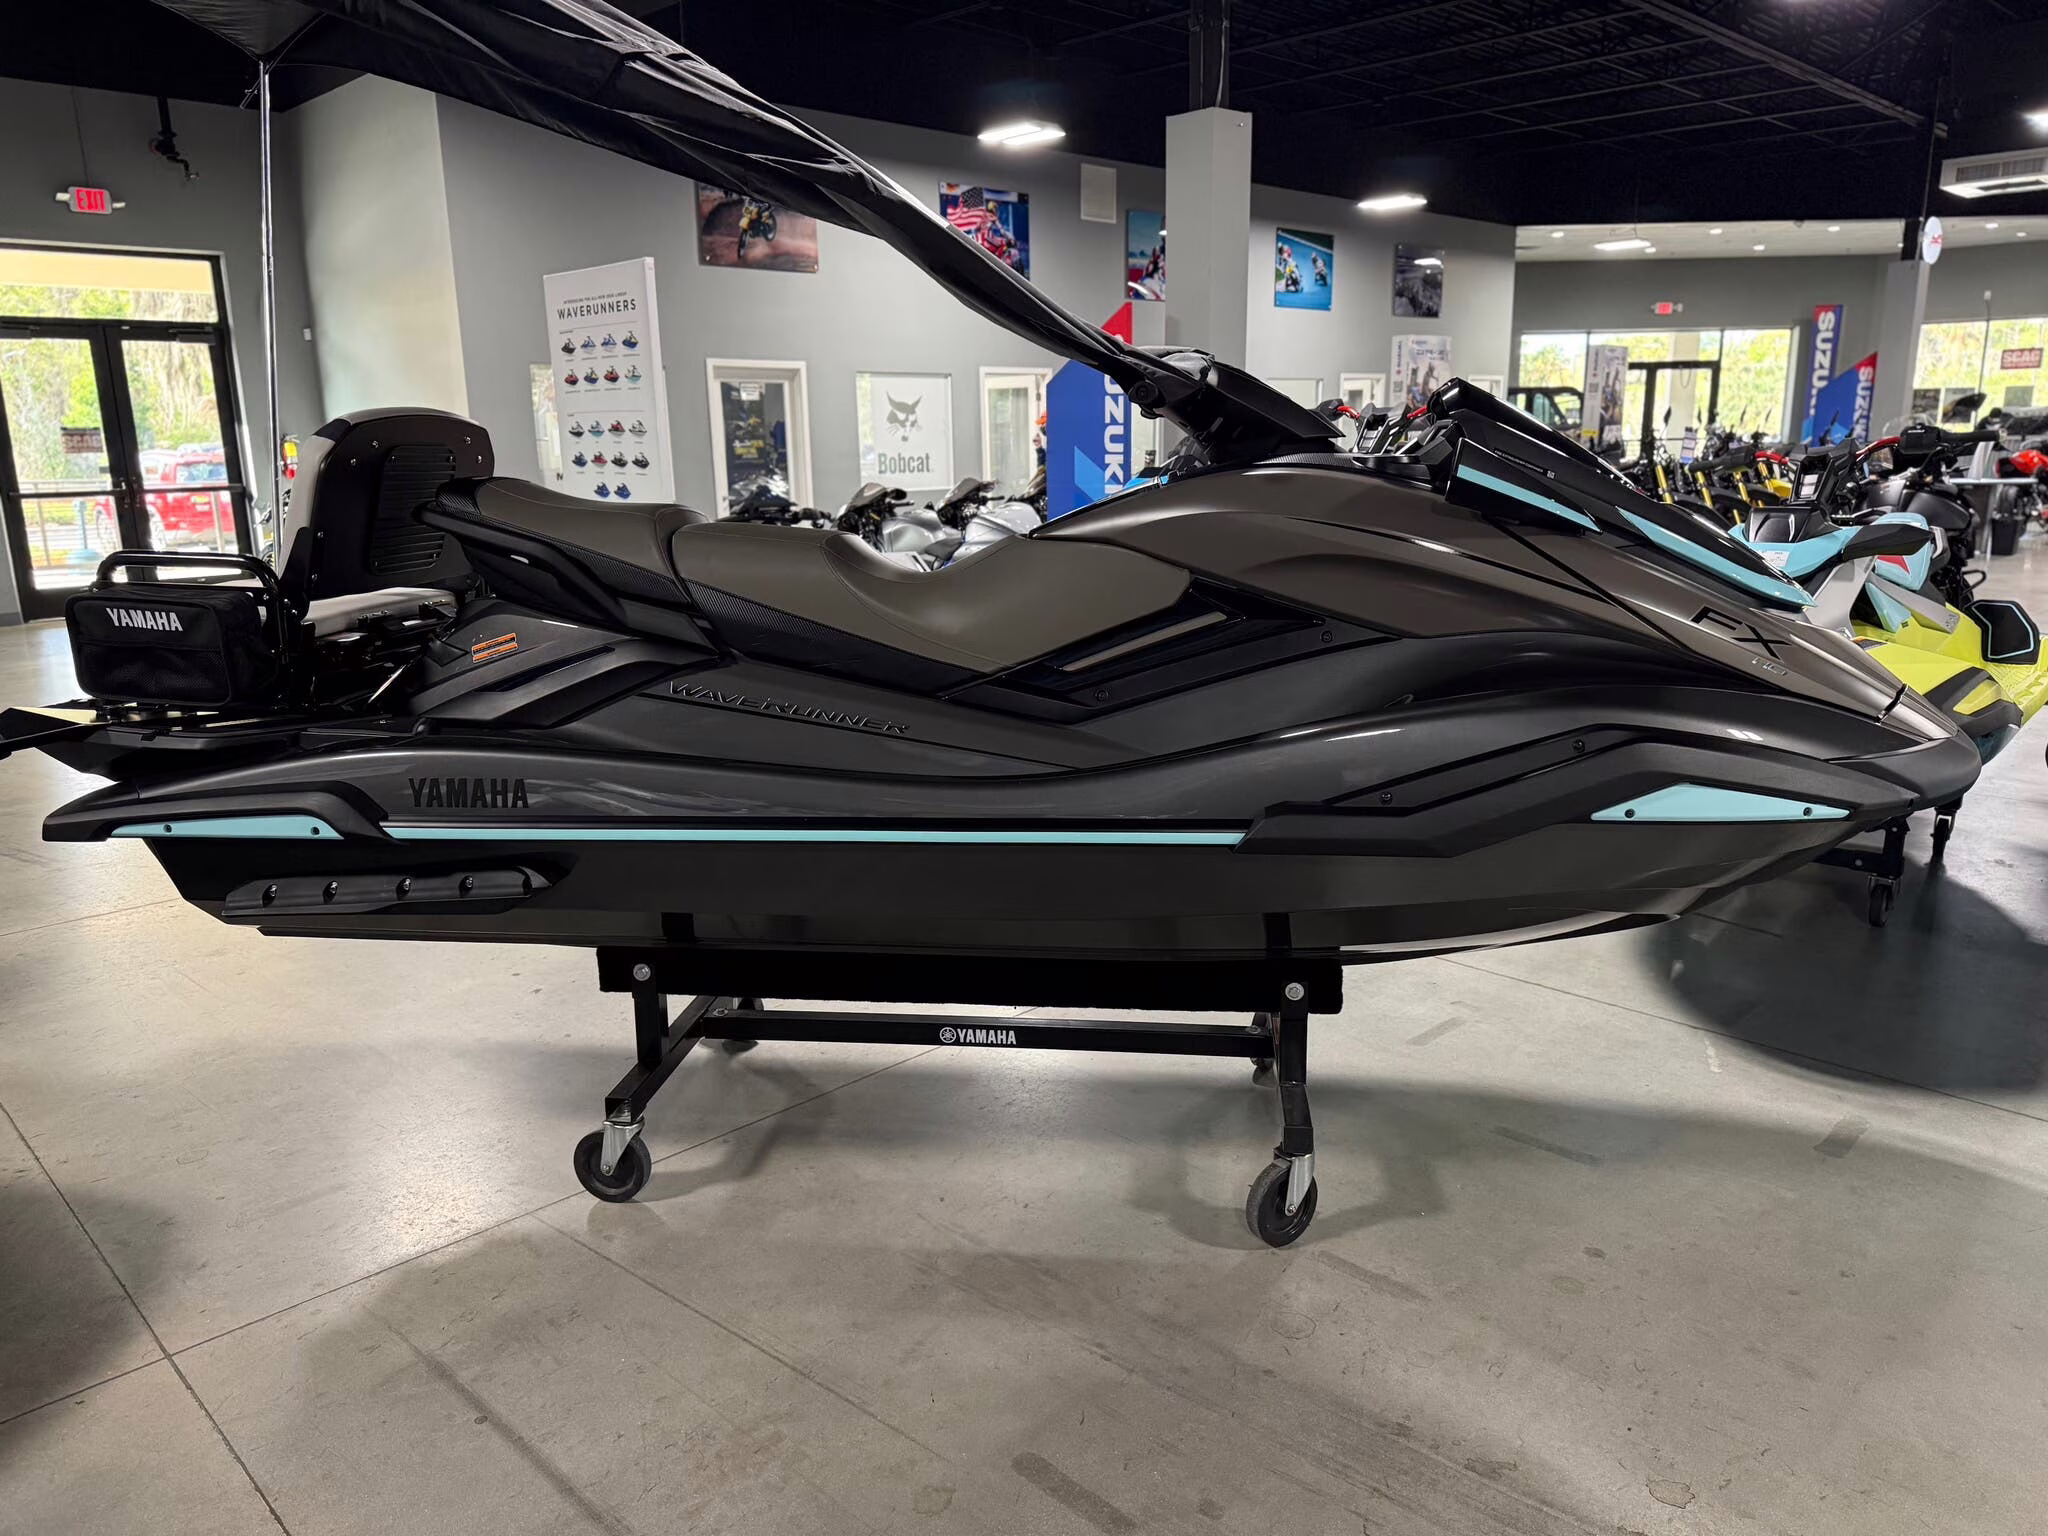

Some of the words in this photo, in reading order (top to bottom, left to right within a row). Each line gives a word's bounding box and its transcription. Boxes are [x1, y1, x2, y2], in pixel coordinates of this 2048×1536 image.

[76, 188, 106, 212] EXIT
[557, 298, 637, 320] WAVERUNNERS
[1104, 334, 1125, 494] UZUKI
[878, 452, 930, 474] Bobcat
[105, 607, 184, 632] YAMAHA
[1690, 605, 1792, 661] FX
[669, 680, 911, 735] WAVERUNNER
[408, 777, 530, 809] YAMAHA
[957, 1028, 1017, 1045] YAMAHA
